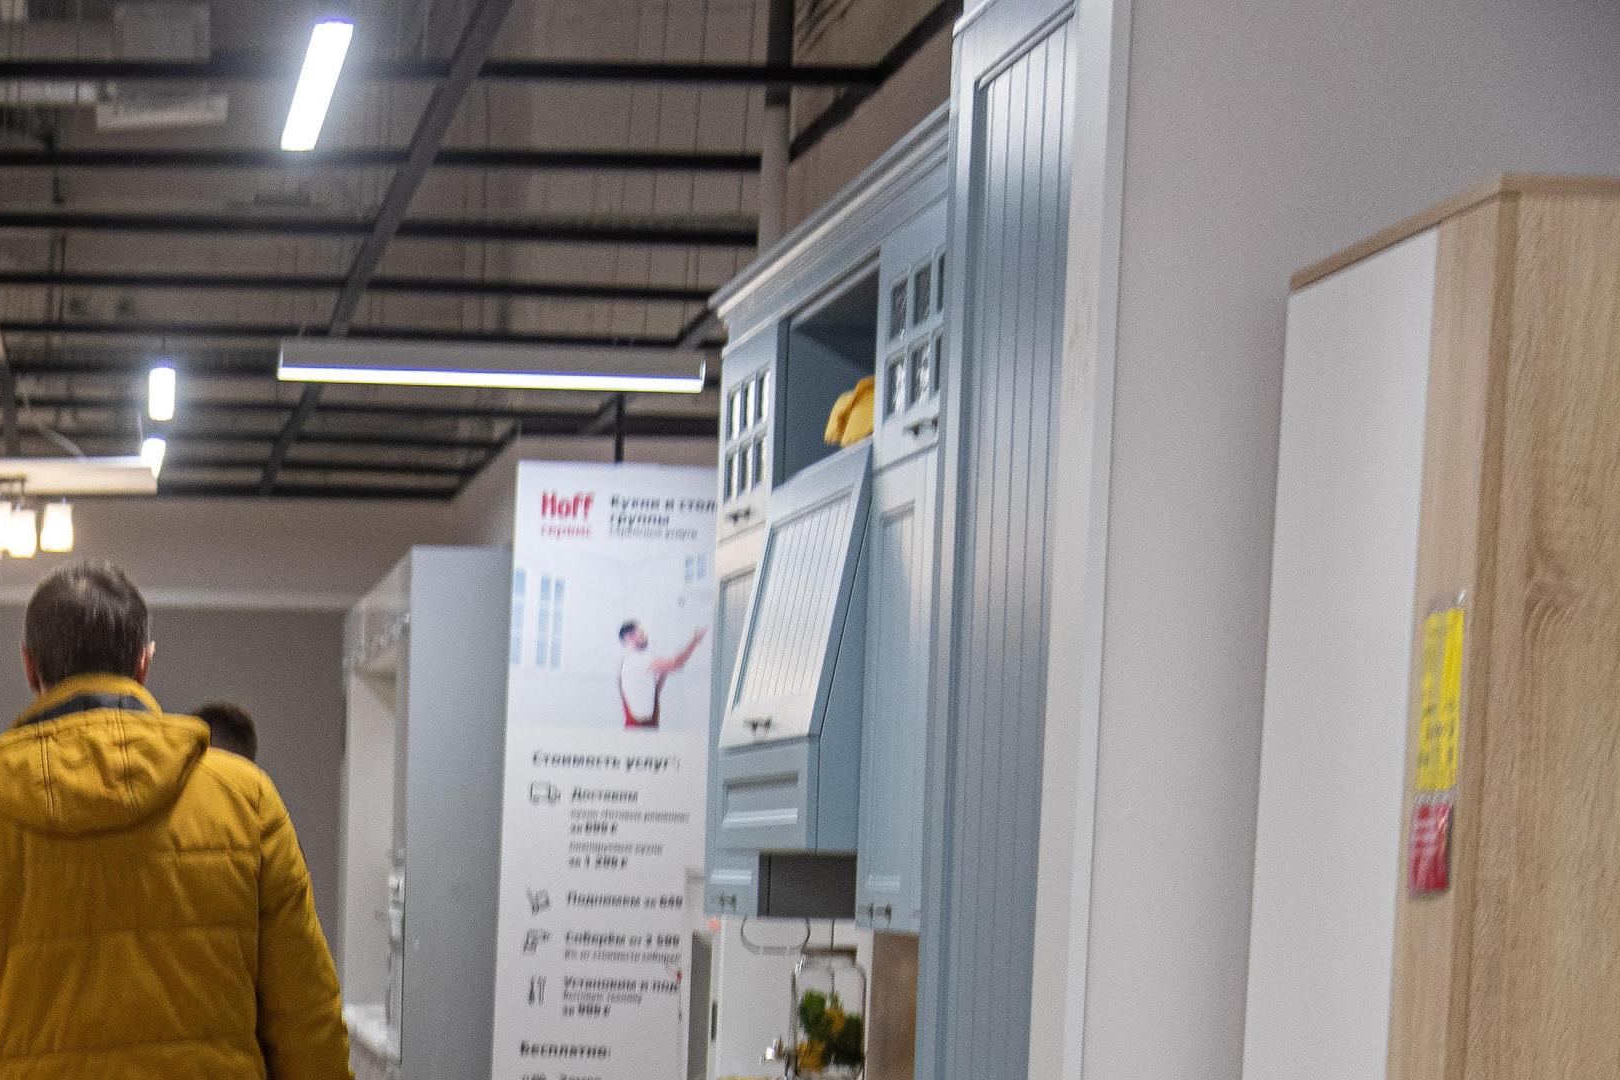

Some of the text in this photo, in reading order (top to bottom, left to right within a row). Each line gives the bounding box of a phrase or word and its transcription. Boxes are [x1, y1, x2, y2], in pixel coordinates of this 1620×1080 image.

[541, 491, 593, 518] Hoff
[611, 494, 661, 511] Кухни
[532, 750, 621, 769] Стоимость
[571, 785, 639, 803] Доставим
